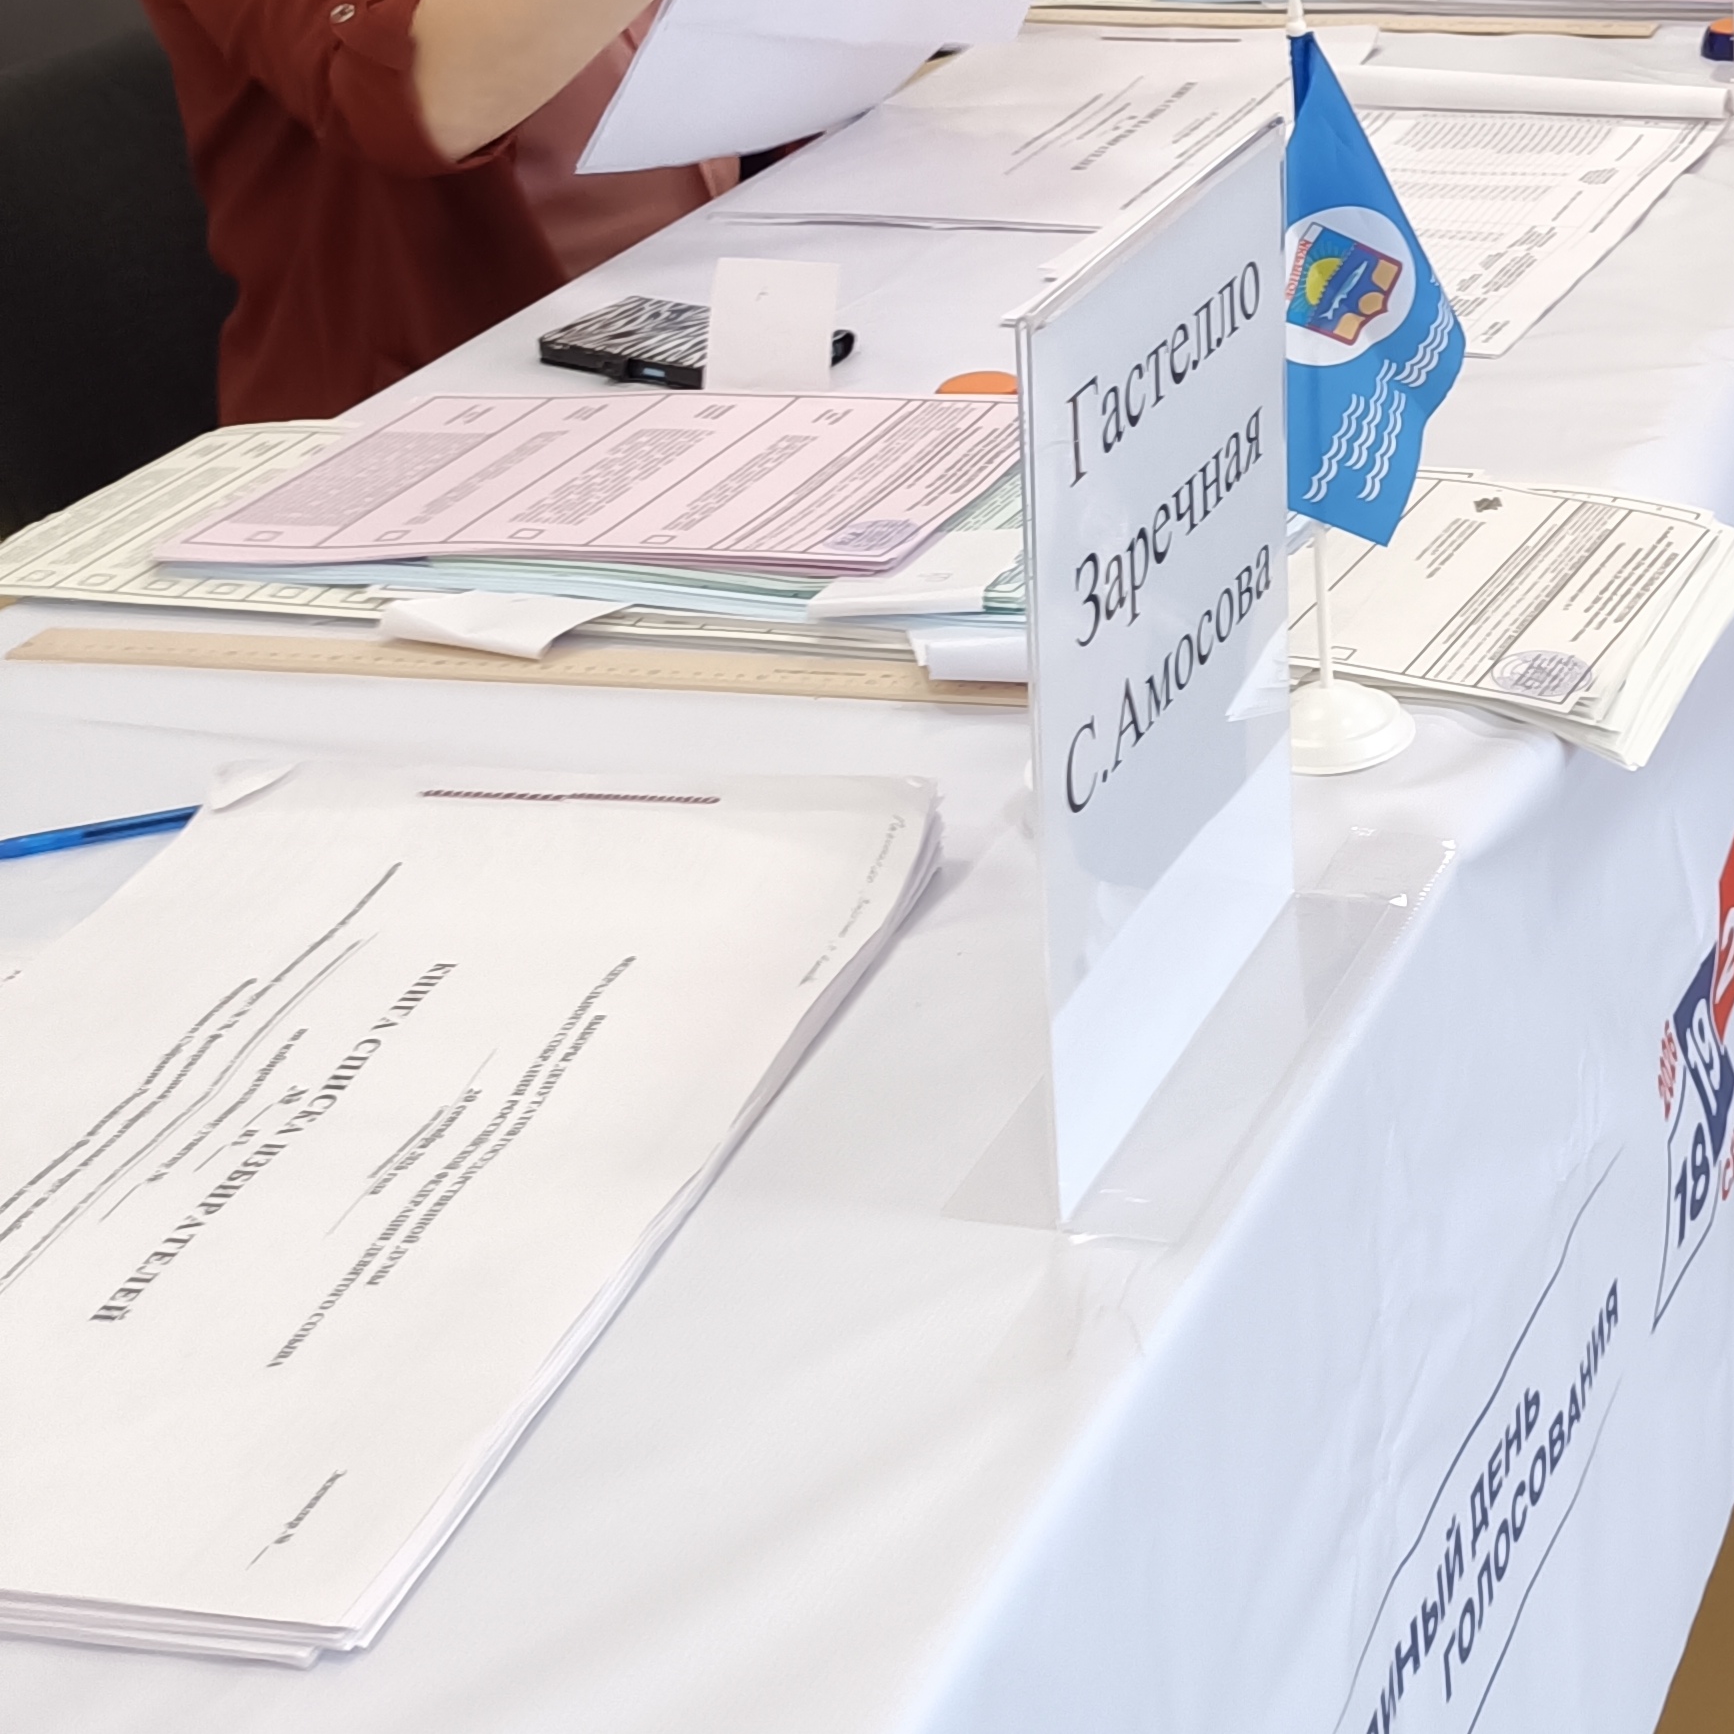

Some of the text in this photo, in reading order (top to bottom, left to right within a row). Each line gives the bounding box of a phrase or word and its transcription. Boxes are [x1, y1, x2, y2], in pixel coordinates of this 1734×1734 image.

[1066, 259, 1262, 488] Гастелло
[1075, 405, 1264, 648] Заречная
[1064, 542, 1272, 815] С.Амосова
[369, 962, 460, 1032] КНИГА
[1657, 1018, 1679, 1123] 2026
[1686, 997, 1722, 1117] 19
[273, 1037, 383, 1136] СПИСКА
[88, 1142, 290, 1322] ИЗБИРАТЕЛЕЙ
[1674, 1122, 1711, 1250] 18
[1442, 1276, 1622, 1704] ГОЛОСОВАНИЯ
[1470, 1386, 1543, 1560] ДЕНЬ
